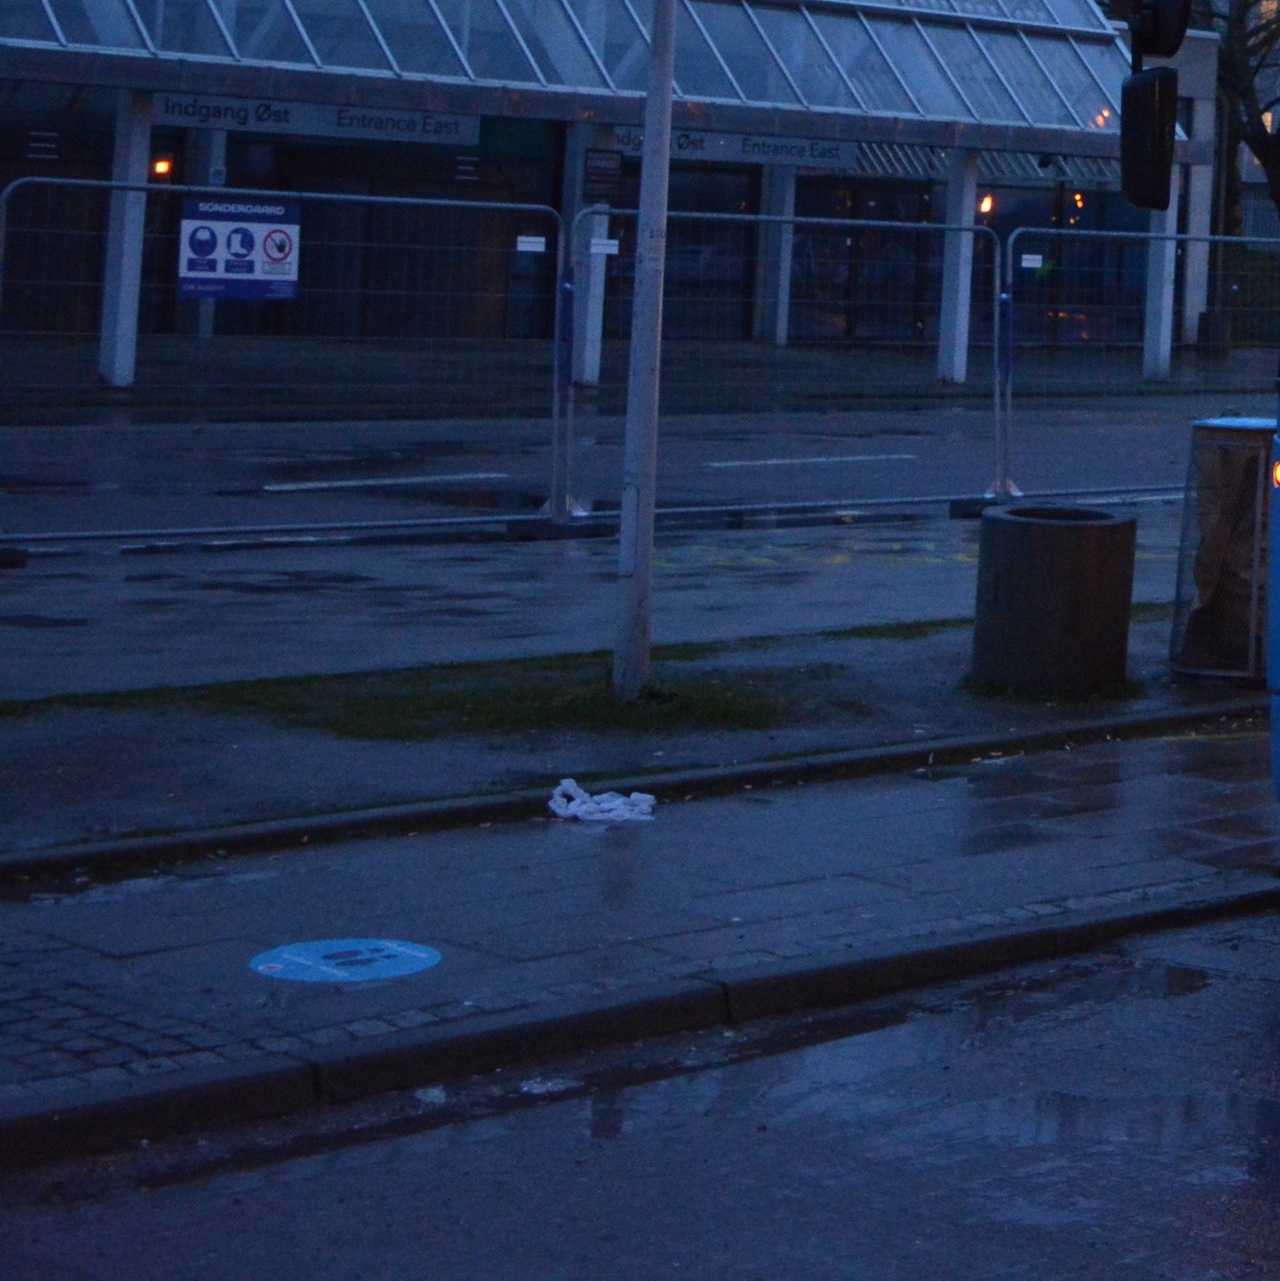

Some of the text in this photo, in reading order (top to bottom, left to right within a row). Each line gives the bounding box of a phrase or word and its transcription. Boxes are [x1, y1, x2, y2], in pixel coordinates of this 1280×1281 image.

[164, 97, 460, 136] Indgang Øst Entrance East
[676, 132, 841, 160] Øst Entrance East
